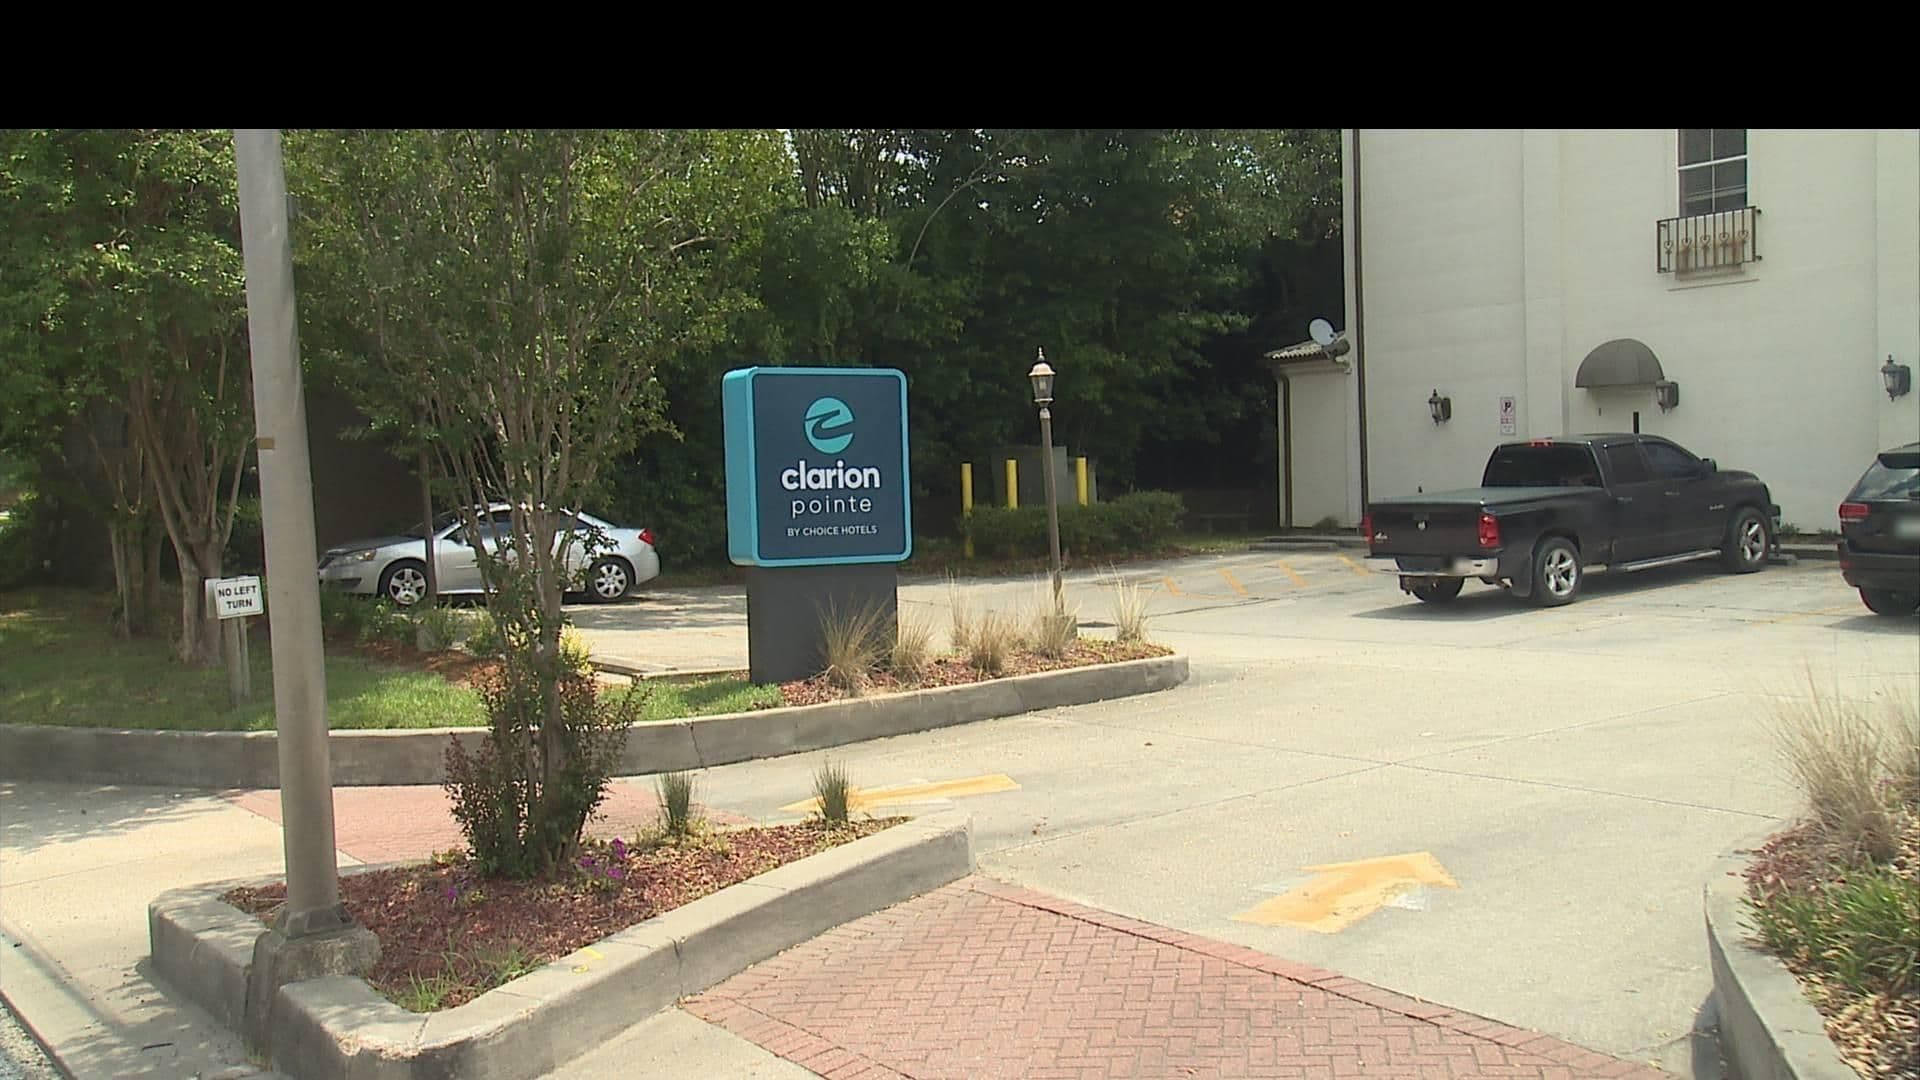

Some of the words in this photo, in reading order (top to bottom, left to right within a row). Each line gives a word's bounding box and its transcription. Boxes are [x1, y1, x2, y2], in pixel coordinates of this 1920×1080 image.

[781, 460, 881, 490] clarion
[792, 495, 872, 519] pointe
[787, 527, 801, 537] BY
[802, 526, 839, 536] CHOICE
[841, 525, 878, 535] HOTELS
[218, 588, 232, 597] NO
[234, 585, 257, 595] LEFT
[226, 599, 253, 609] TURN
